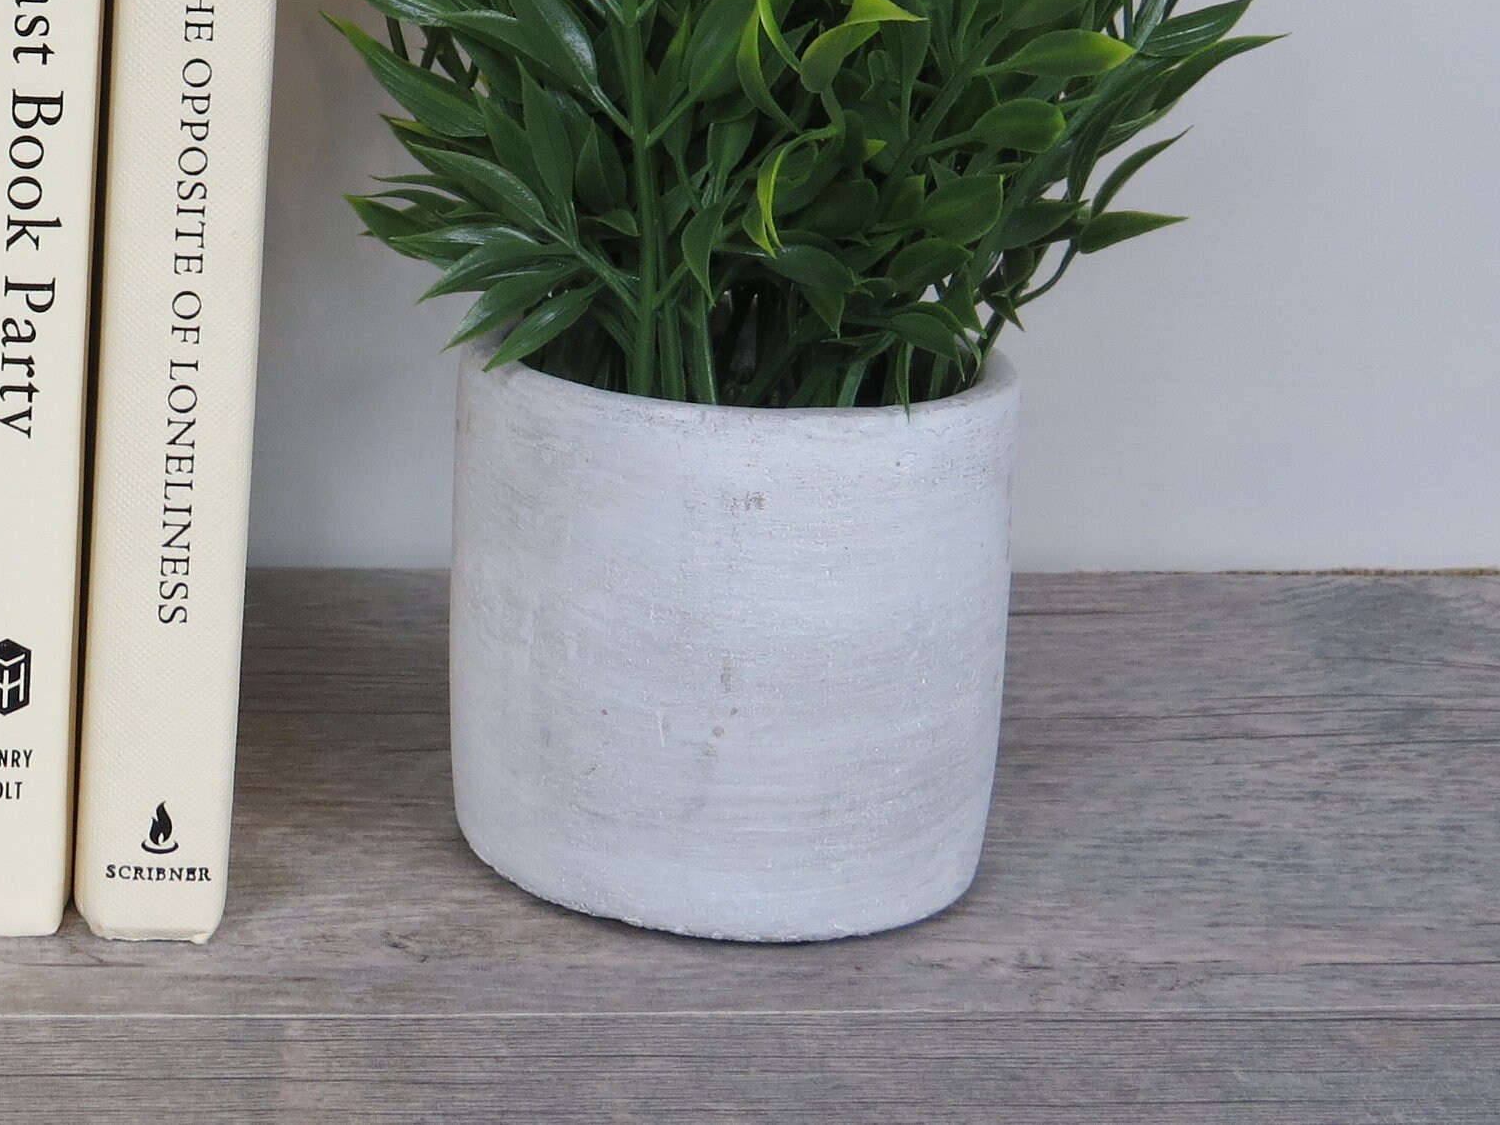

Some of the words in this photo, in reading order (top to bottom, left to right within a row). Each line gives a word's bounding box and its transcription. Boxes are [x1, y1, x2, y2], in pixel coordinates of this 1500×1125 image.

[5, 88, 64, 252] Book
[174, 58, 213, 275] OPPOSITE
[171, 290, 202, 345] OF
[158, 359, 199, 624] LONELINESS
[105, 864, 212, 882] SCRIBNER
